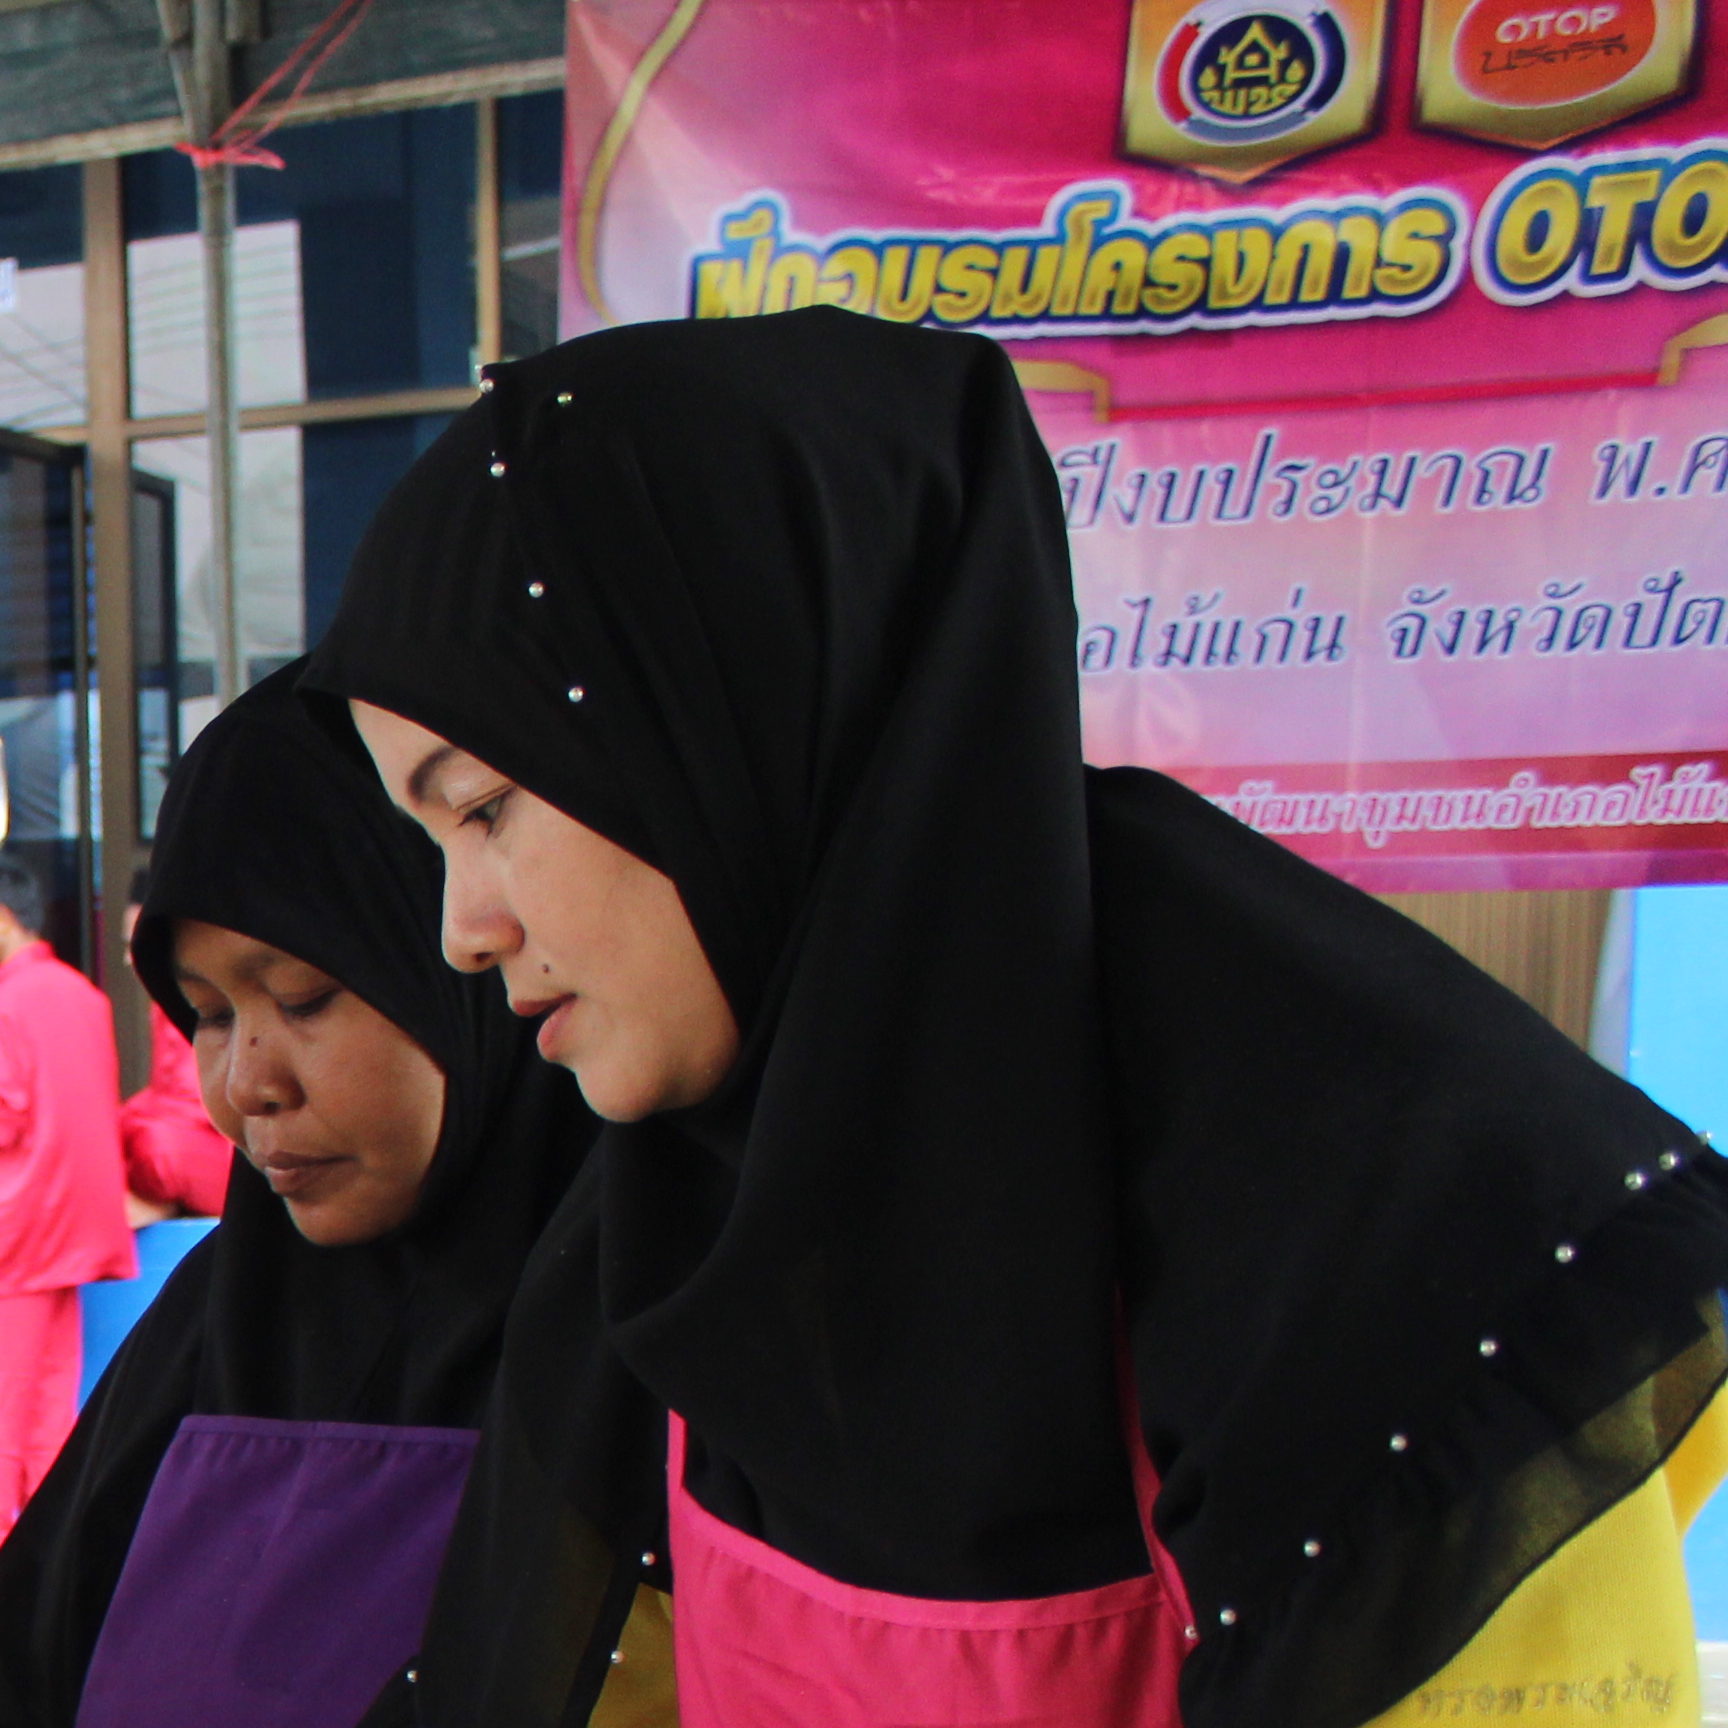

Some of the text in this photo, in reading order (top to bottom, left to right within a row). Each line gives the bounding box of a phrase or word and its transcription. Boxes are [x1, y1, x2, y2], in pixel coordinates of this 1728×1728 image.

[1494, 4, 1621, 44] OTOP
[1058, 432, 1552, 530] ปีงบประมาณ
[1081, 570, 1728, 670] อไม้แก่น จังหวัดปัต
